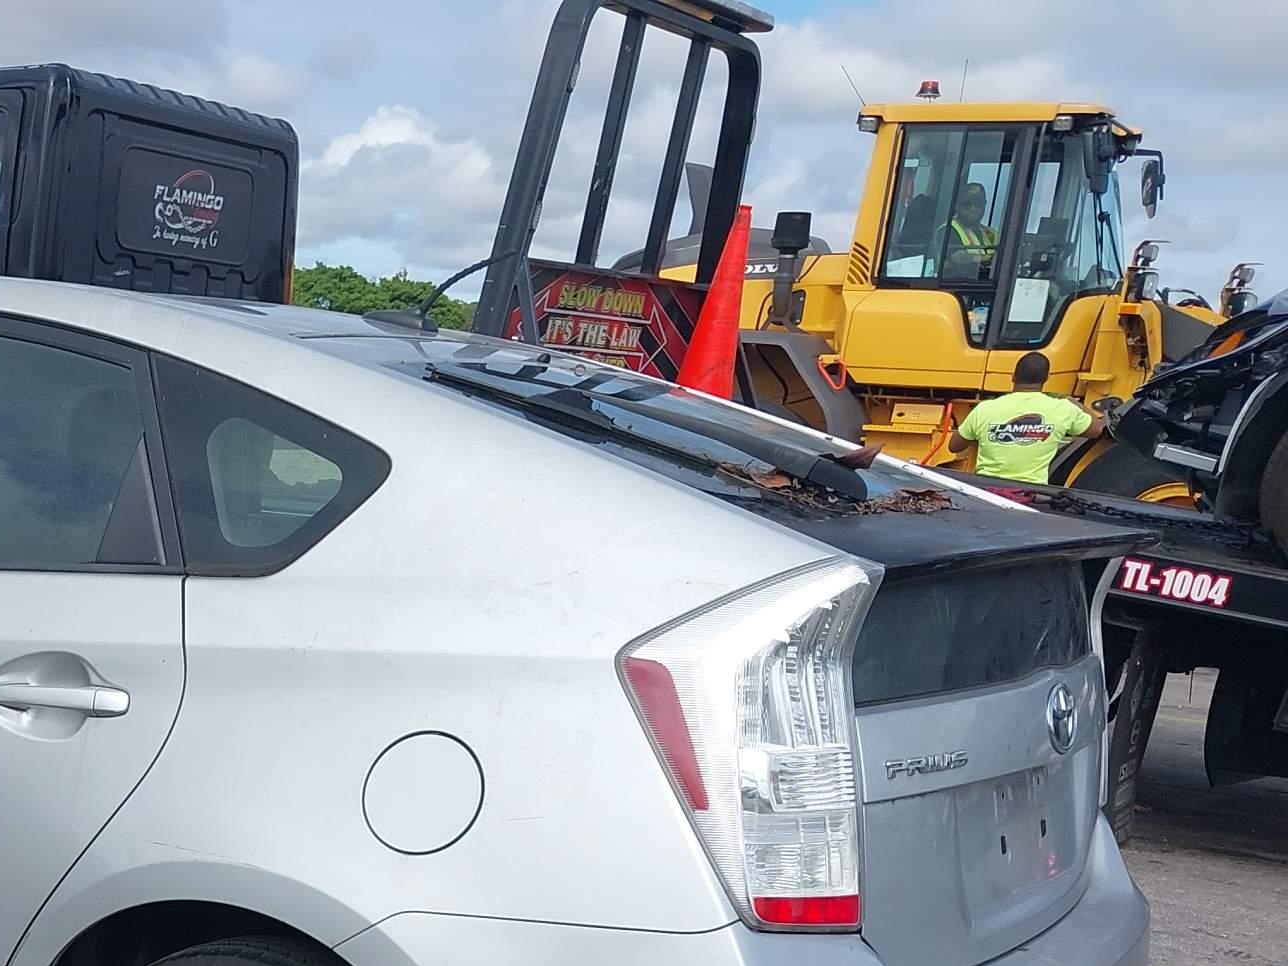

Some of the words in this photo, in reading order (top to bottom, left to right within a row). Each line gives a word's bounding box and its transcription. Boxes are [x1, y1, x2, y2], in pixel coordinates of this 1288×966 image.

[154, 184, 224, 211] FLAMINGO
[744, 264, 779, 274] OLV
[559, 281, 599, 310] SLOW
[601, 287, 645, 317] DOWN
[544, 317, 573, 343] IT'S
[576, 322, 608, 347] THE
[610, 324, 643, 350] LAW
[989, 424, 1054, 433] FLAMINGO
[1122, 559, 1231, 606] TL-1004
[885, 749, 969, 780] PRIUS
